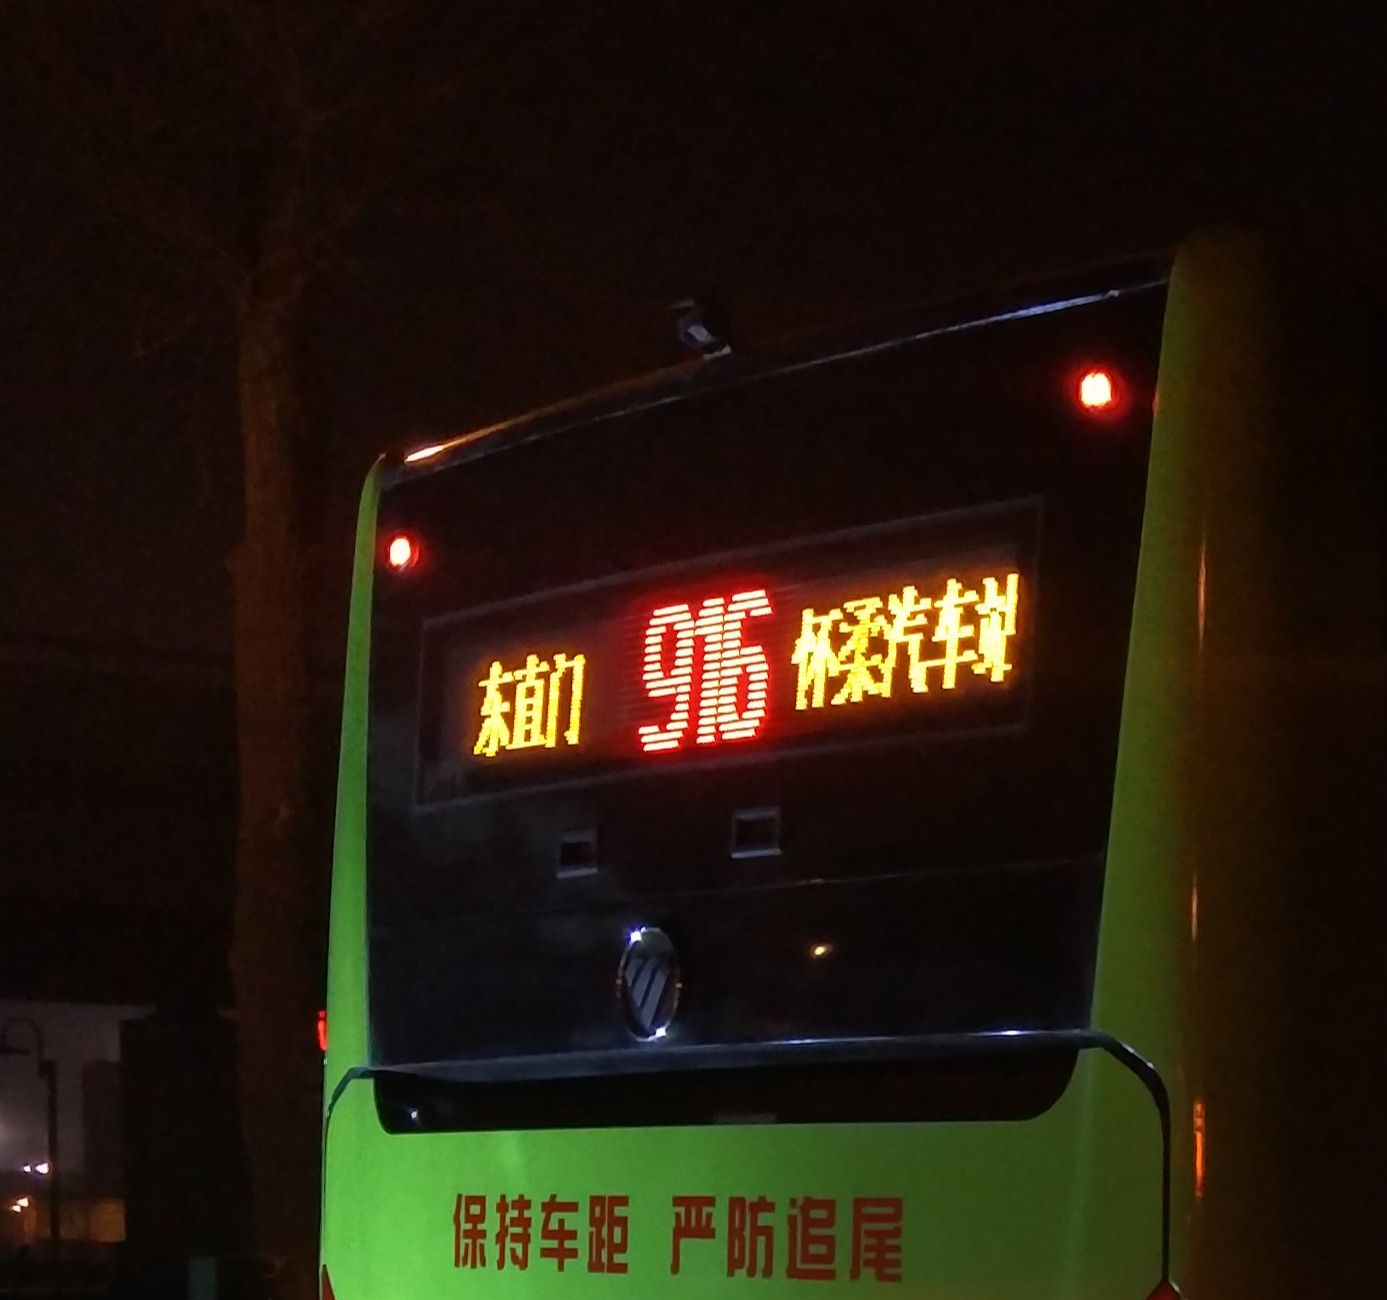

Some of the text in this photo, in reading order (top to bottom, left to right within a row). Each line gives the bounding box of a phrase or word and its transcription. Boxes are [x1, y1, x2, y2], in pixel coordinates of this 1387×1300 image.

[472, 572, 1021, 758] 东直门 916 怀柔汽车站
[452, 1192, 905, 1283] 保持车距 严防追尾
